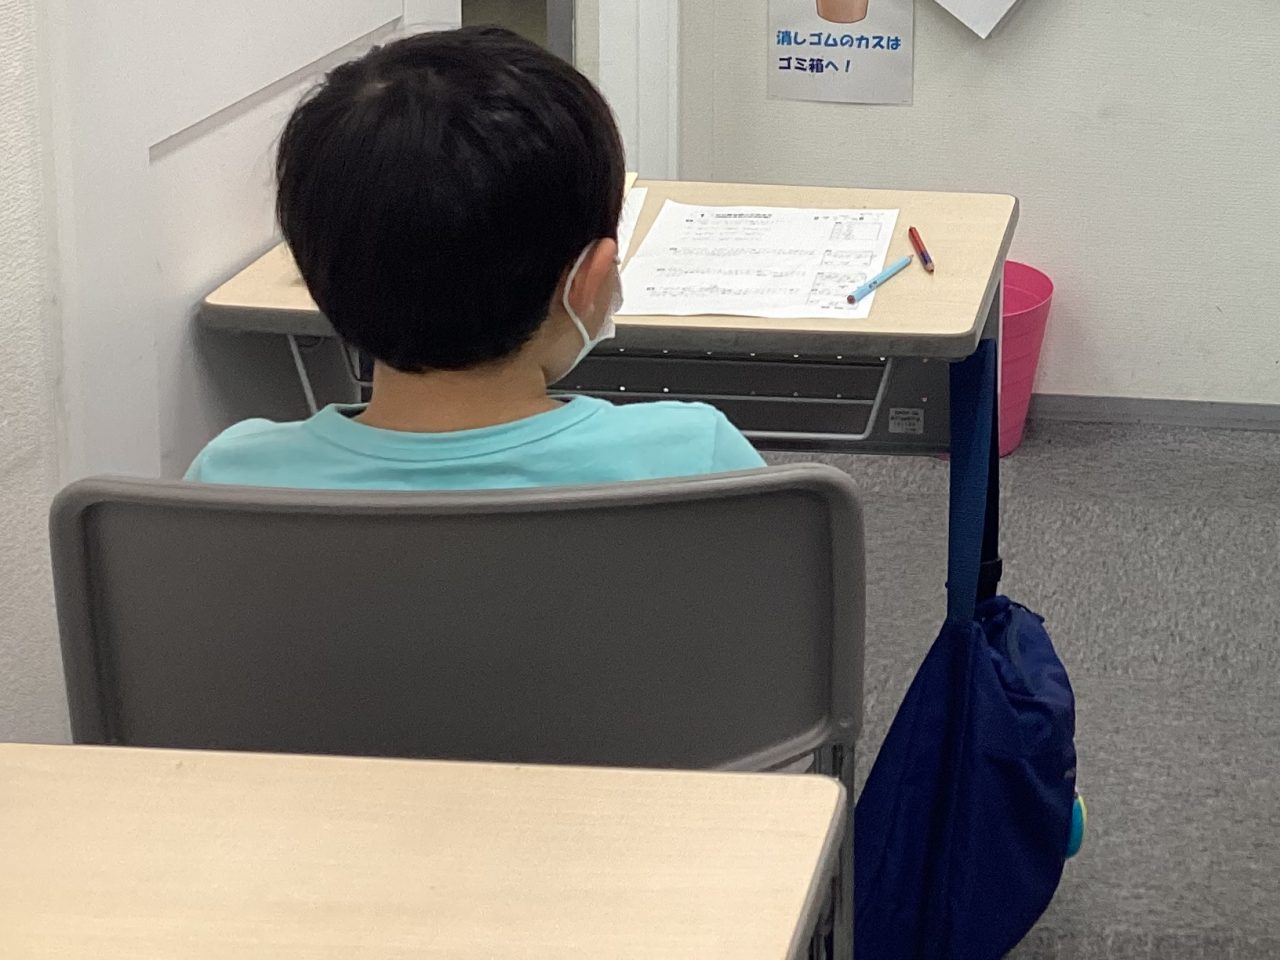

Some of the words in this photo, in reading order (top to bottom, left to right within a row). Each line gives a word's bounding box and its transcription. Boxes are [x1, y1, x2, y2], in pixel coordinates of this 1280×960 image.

[776, 29, 902, 51] 消しゴムのカスは
